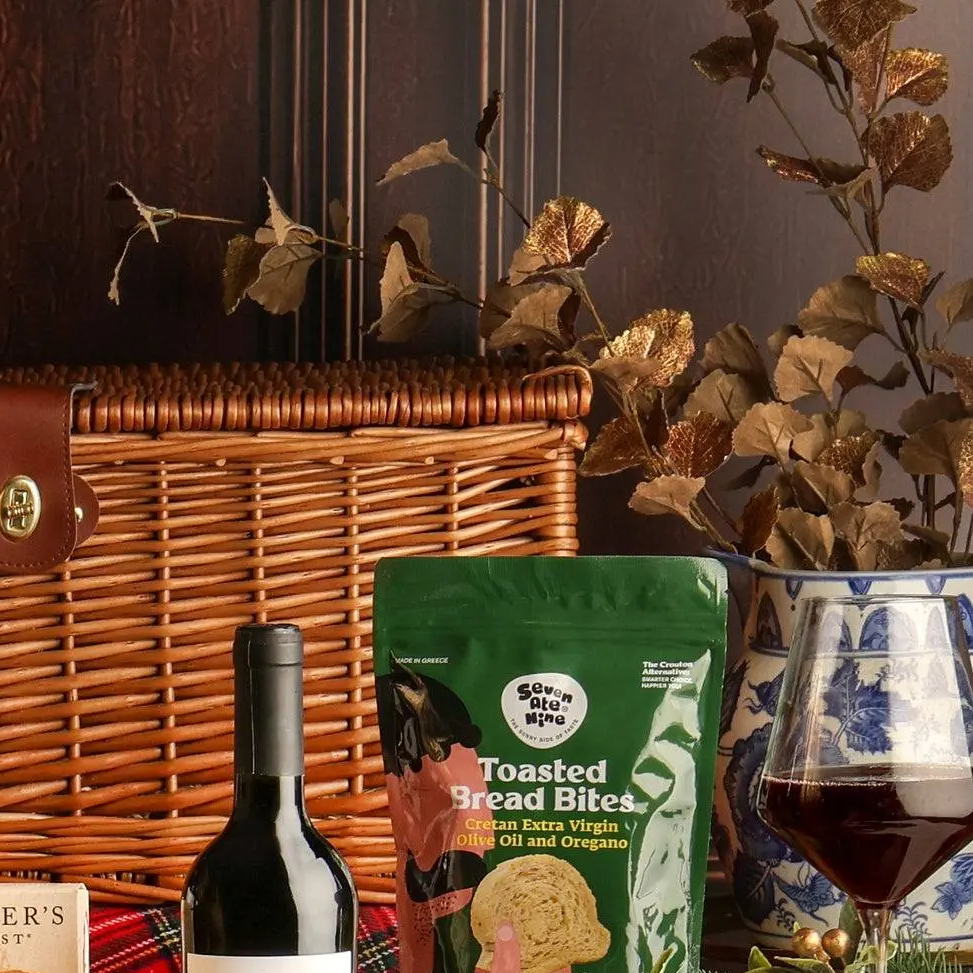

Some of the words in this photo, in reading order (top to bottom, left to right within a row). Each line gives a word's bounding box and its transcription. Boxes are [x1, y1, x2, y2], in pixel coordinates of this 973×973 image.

[517, 682, 573, 704] Seven
[530, 697, 560, 711] Ate
[525, 712, 565, 728] Nine
[477, 757, 607, 785] Toasted
[450, 785, 545, 811] Bread
[554, 786, 636, 813] Bites
[465, 818, 518, 832] Cretan
[522, 818, 564, 832] Extra
[568, 819, 619, 835] Virgin
[457, 832, 495, 847] Olive
[500, 833, 523, 847] Oil
[527, 834, 557, 848] and
[561, 834, 629, 852] Oregano
